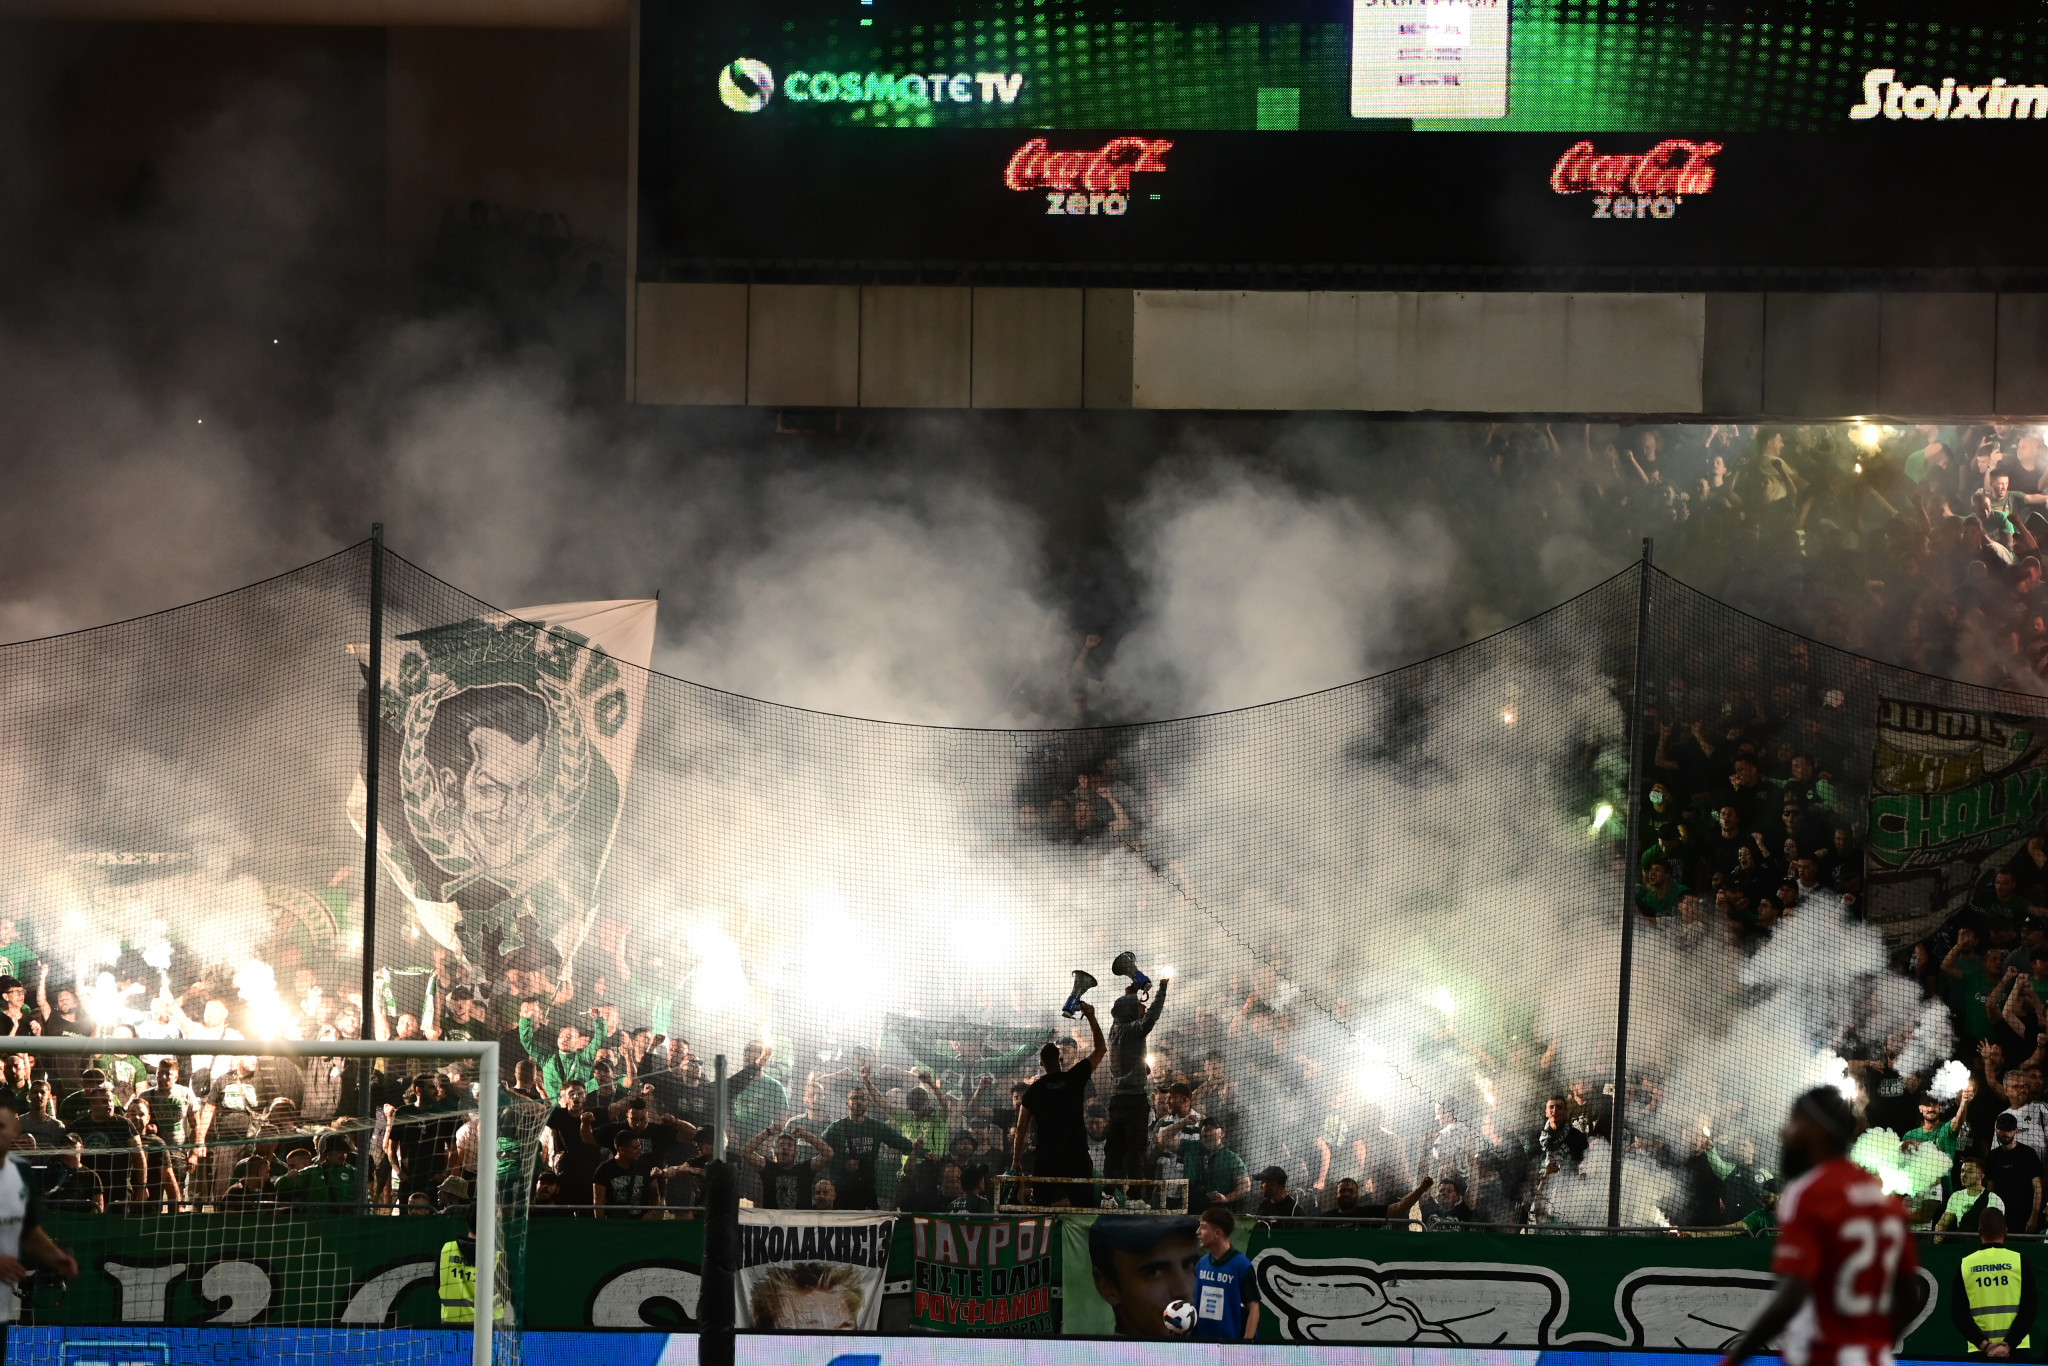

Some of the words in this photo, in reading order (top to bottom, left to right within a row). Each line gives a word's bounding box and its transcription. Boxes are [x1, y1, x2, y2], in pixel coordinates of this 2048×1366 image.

[974, 72, 1024, 103] TV
[1045, 192, 1128, 216] zero
[1591, 195, 1677, 219] zero
[1870, 764, 2048, 853] CHALK
[451, 1267, 476, 1283] 111
[1199, 1269, 1215, 1281] BALL
[1217, 1272, 1234, 1284] BOY
[1973, 1263, 2013, 1273] BRINKS
[1976, 1275, 2009, 1288] 1018
